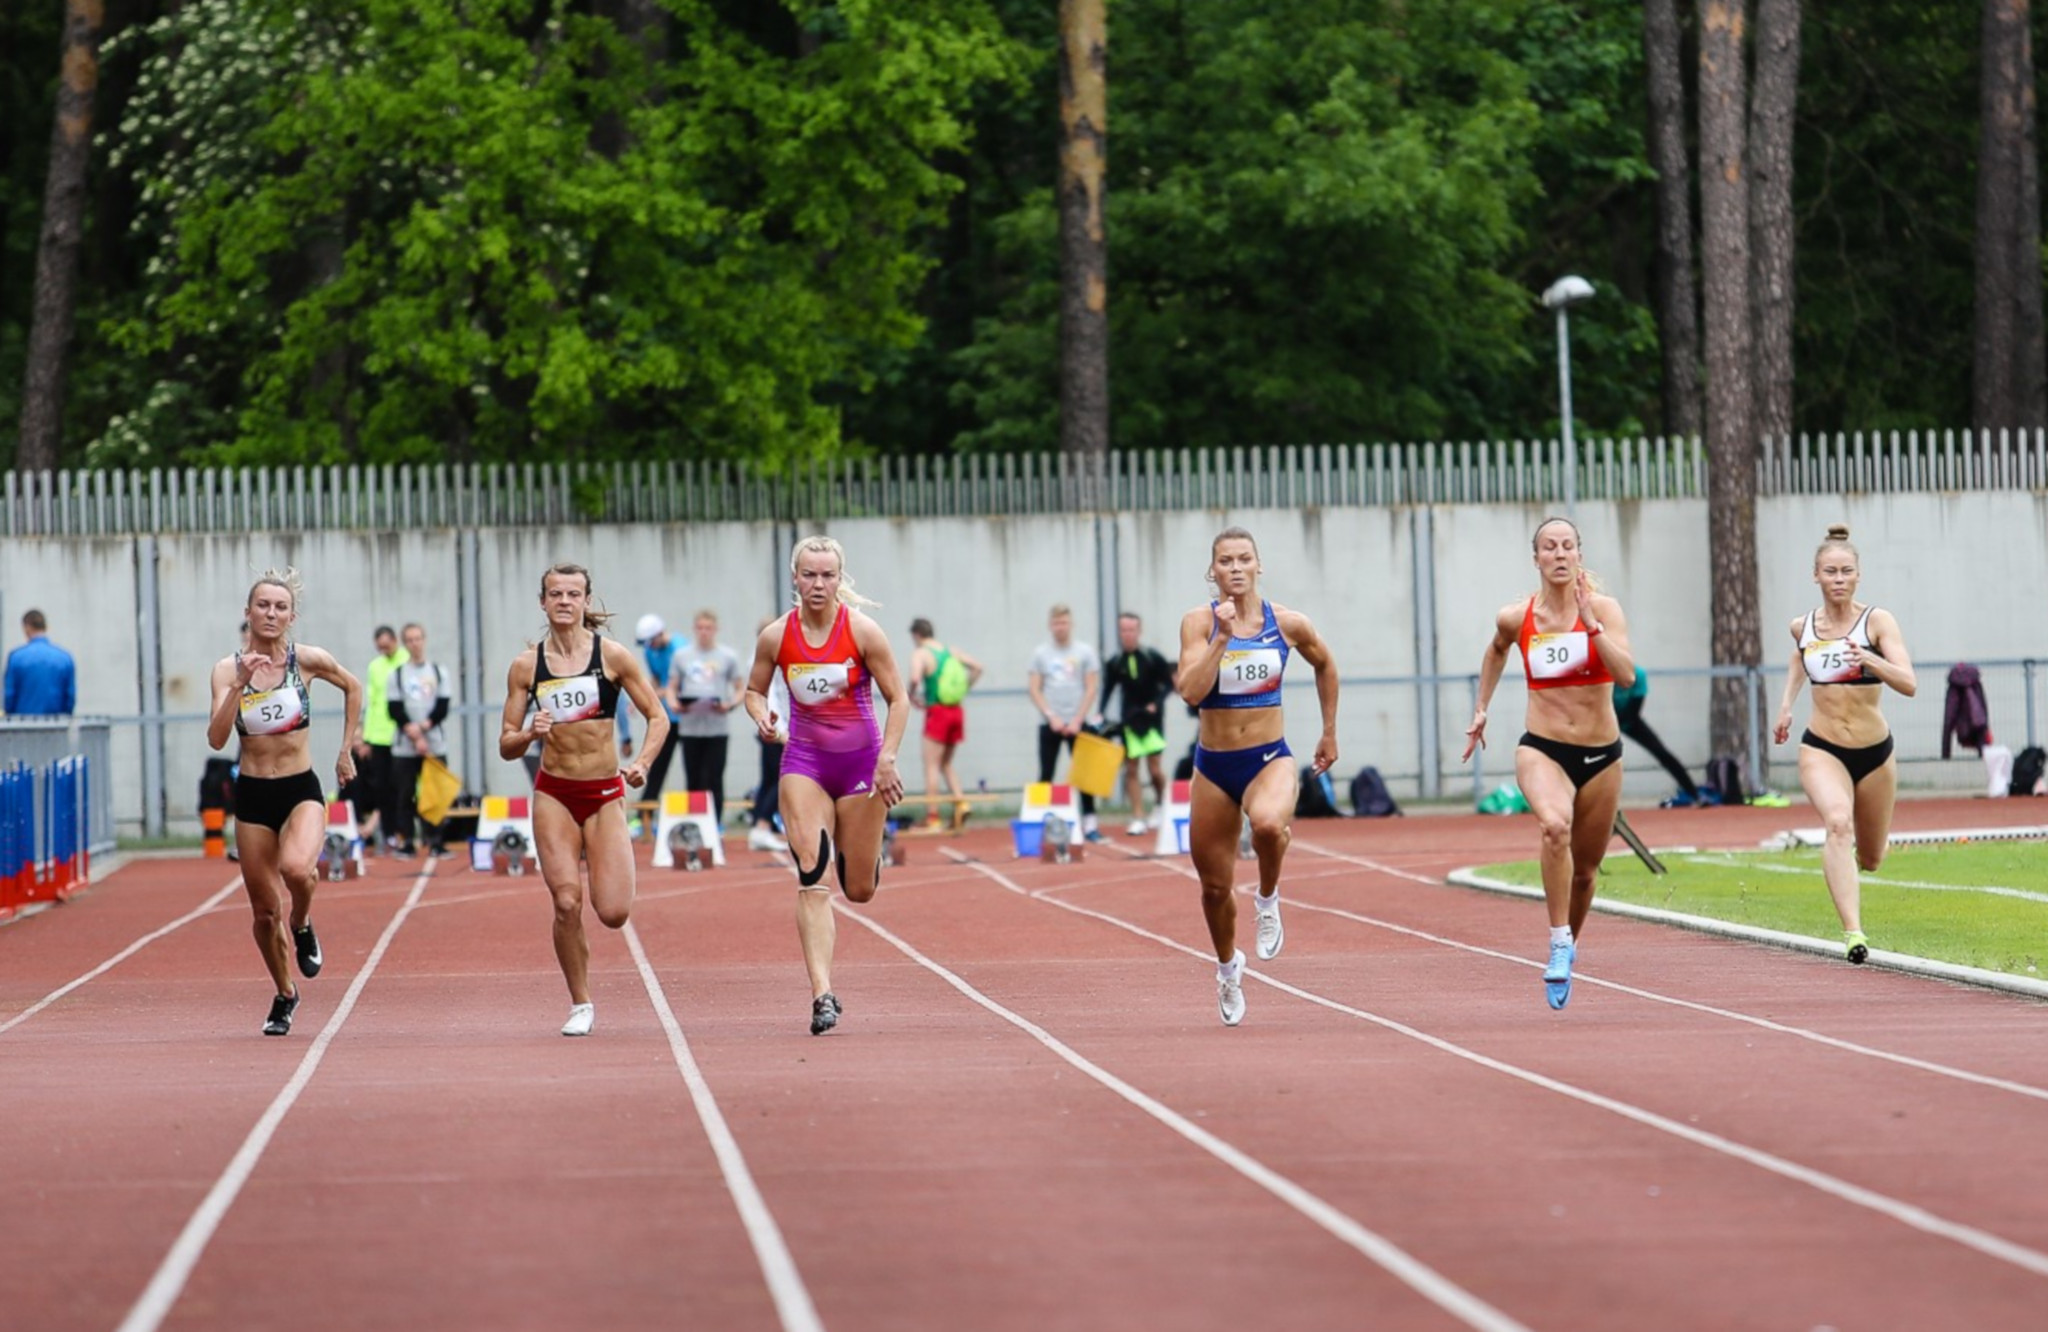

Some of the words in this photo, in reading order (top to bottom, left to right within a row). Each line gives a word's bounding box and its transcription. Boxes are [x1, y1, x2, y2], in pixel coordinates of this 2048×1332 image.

[1546, 647, 1569, 664] 30
[1821, 653, 1842, 669] 75
[1234, 664, 1268, 681] 188
[806, 678, 829, 693] 42
[551, 691, 586, 709] 130
[261, 704, 285, 722] 52
